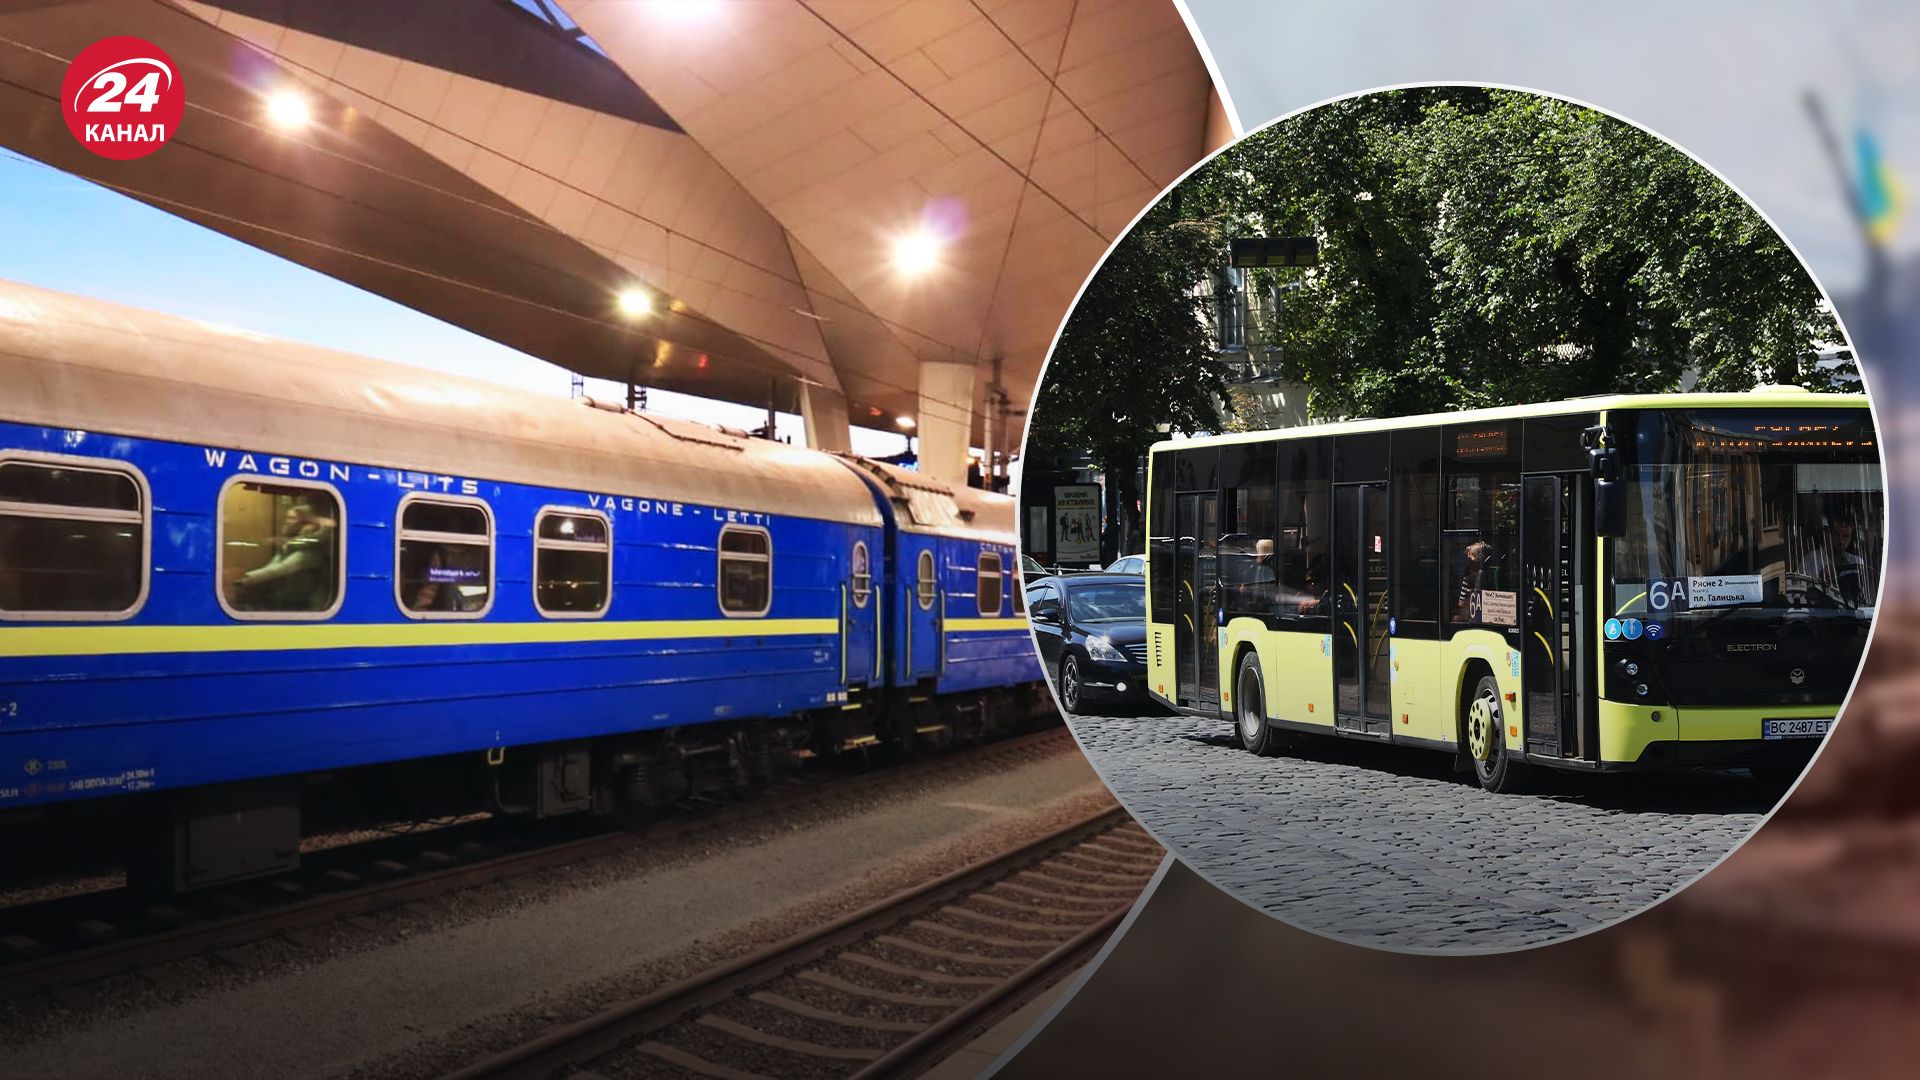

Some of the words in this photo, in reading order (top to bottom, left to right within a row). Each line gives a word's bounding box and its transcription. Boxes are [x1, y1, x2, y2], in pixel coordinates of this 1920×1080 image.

[204, 449, 350, 481] WAGON
[397, 471, 479, 495] LITS
[588, 494, 684, 516] VAGONE
[713, 508, 771, 526] LETTI
[1692, 580, 1716, 588] Рясне
[1717, 579, 1723, 587] 2
[1649, 581, 1687, 610] 6А
[1708, 594, 1745, 602] Галицька
[1727, 643, 1777, 652] ELECTRON
[1789, 721, 1814, 734] 2487
